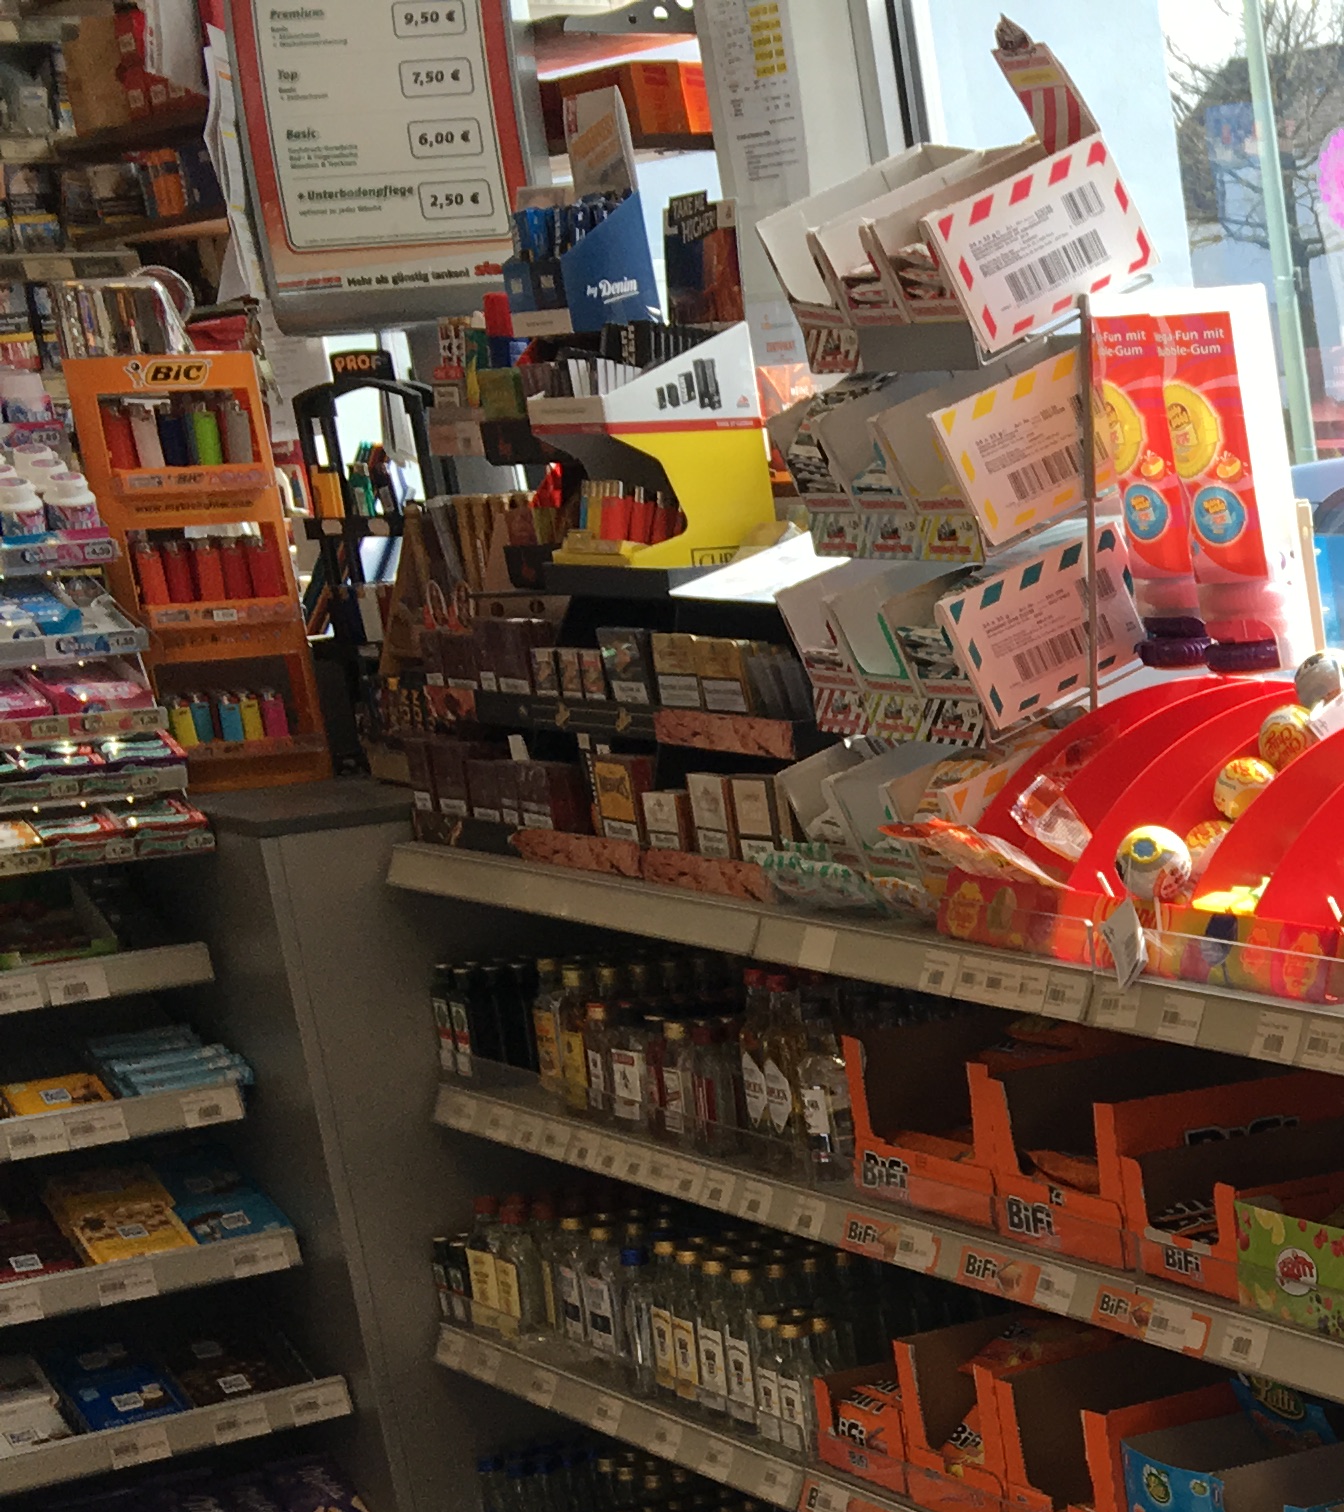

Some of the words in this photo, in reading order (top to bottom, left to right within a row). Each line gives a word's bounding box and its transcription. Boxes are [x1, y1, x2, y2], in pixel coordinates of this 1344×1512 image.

[404, 12, 439, 26] 9,50
[278, 69, 298, 82] Top
[412, 70, 444, 86] 7,50
[286, 128, 316, 140] Basic
[419, 131, 454, 147] 6,00
[308, 185, 414, 201] Unterbodenpflege
[430, 193, 463, 209] 2,50
[348, 275, 372, 287] Mehr
[392, 270, 428, 286] günstig
[847, 1219, 878, 1245] BiFi
[965, 1253, 997, 1280] BiFi
[1100, 1293, 1129, 1316] BiFi
